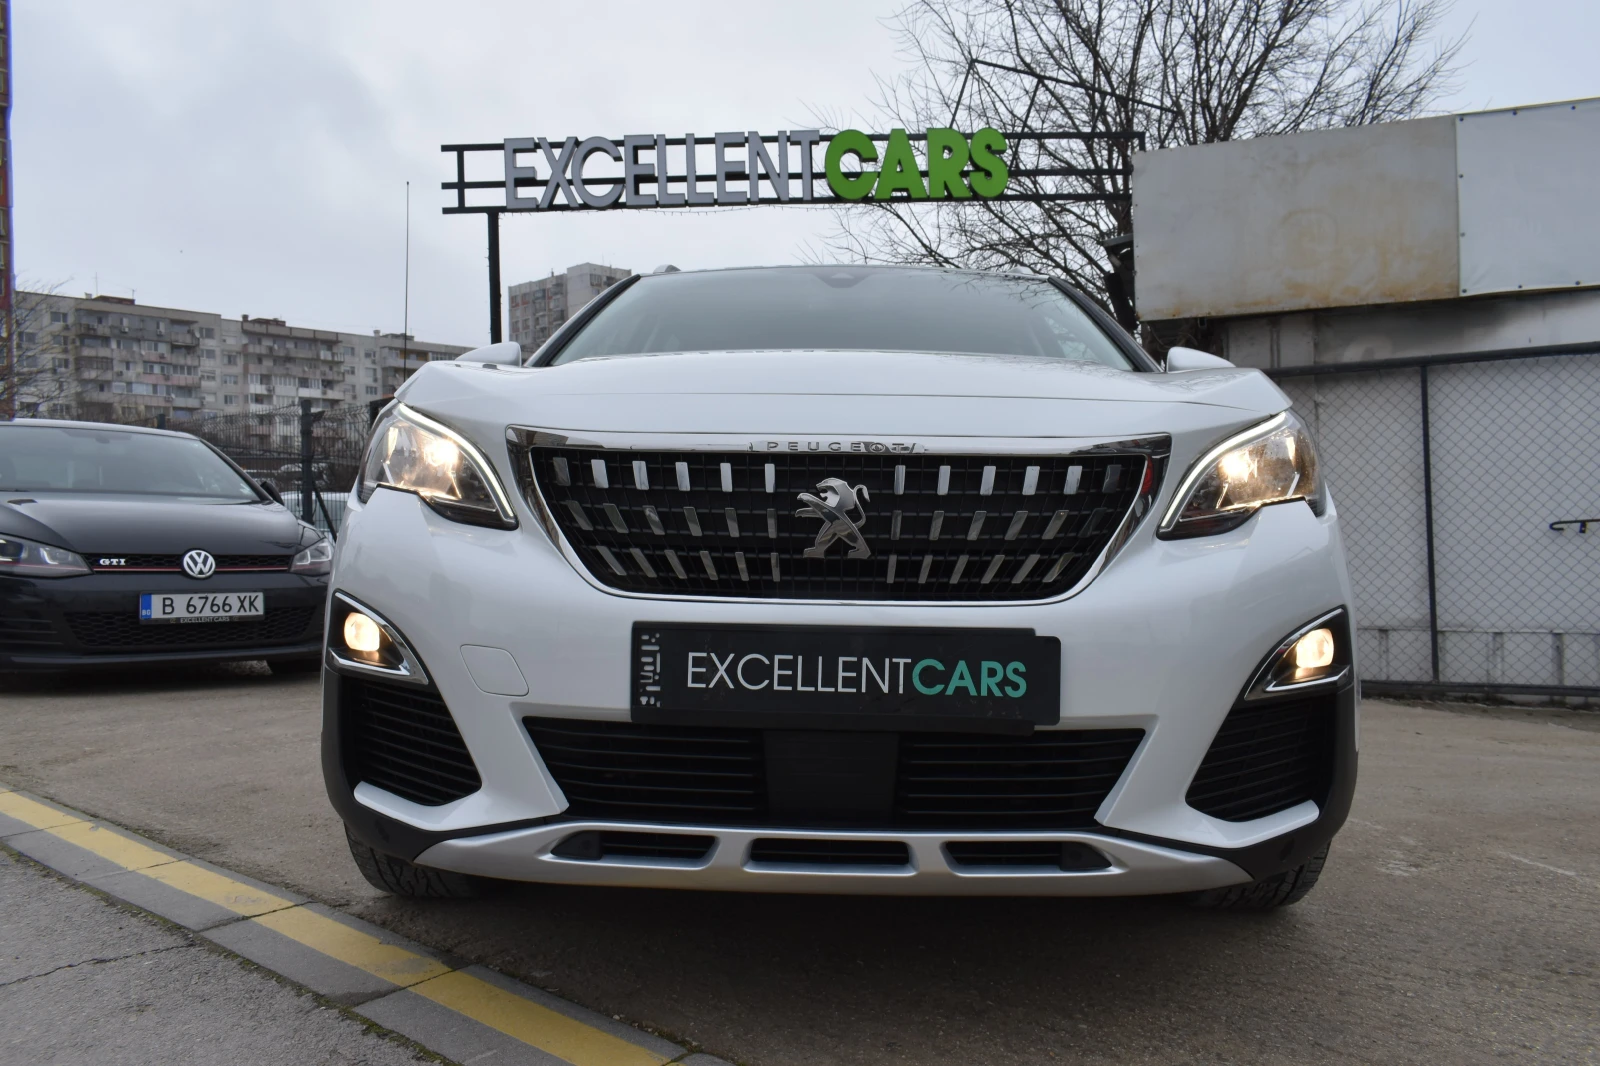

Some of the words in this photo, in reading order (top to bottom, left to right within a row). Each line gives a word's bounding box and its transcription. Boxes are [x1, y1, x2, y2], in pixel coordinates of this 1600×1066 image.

[766, 441, 905, 454] PEUGEOT
[99, 558, 126, 566] GTI
[162, 597, 175, 615] B
[186, 595, 232, 614] 6766
[237, 595, 259, 613] XK
